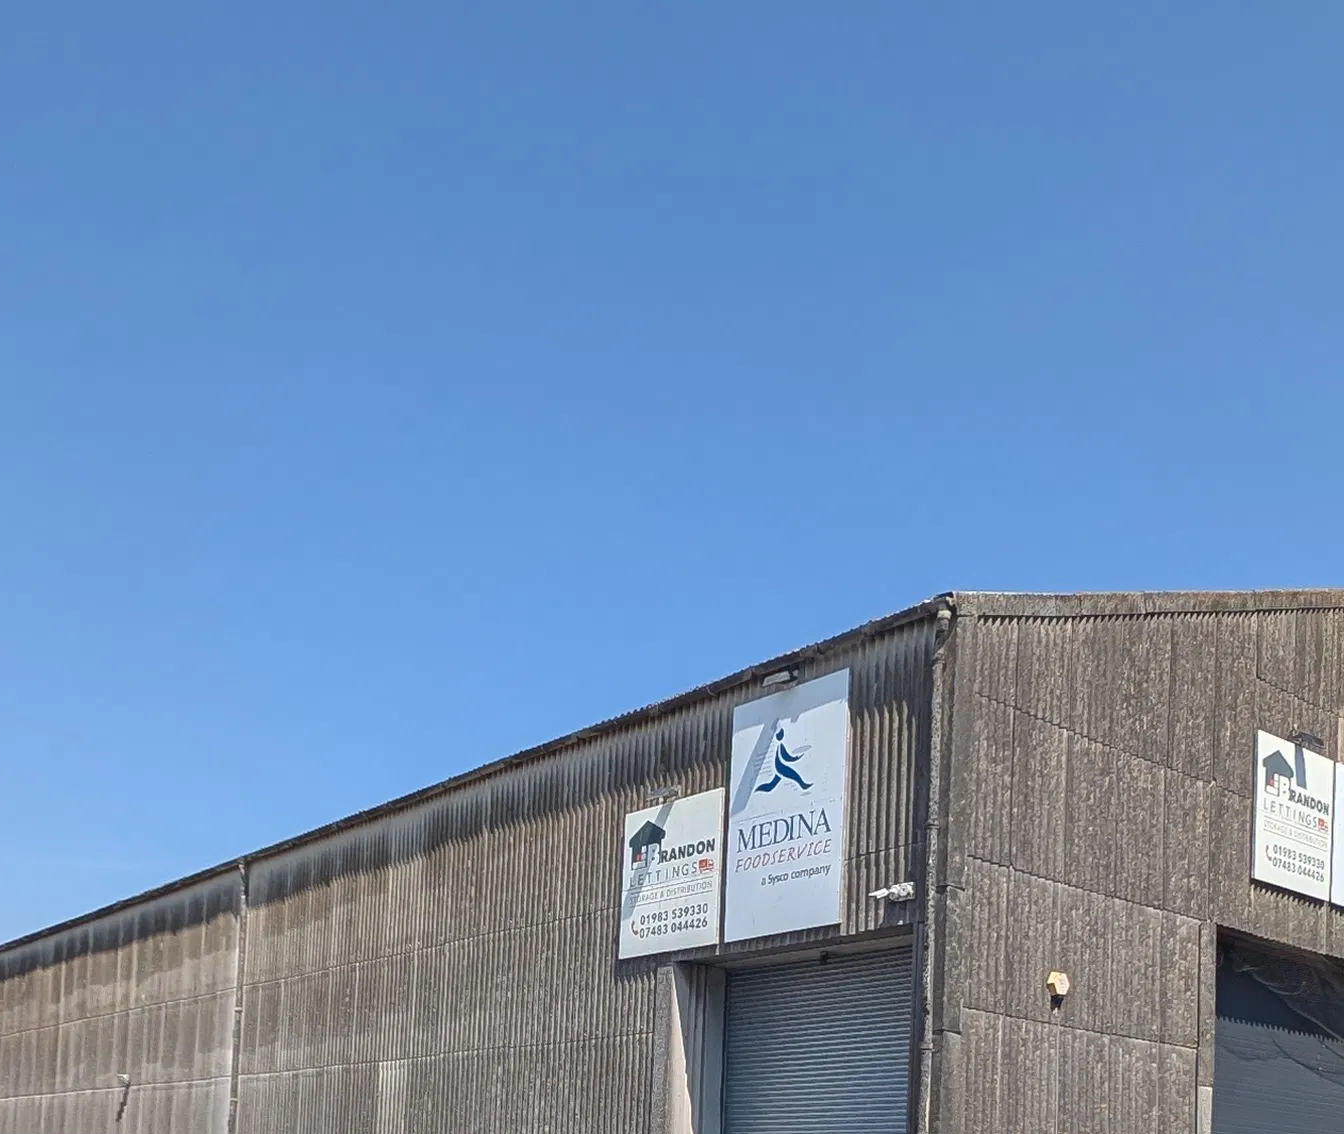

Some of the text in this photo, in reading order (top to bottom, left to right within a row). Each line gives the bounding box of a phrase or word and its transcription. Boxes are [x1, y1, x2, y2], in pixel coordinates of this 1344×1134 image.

[1263, 798, 1317, 828] LETTINGS
[737, 807, 832, 853] MEDINA
[735, 839, 832, 873] FOODSERVICE
[1272, 844, 1297, 861] 01983
[629, 861, 697, 888] LETTINGS
[761, 864, 831, 886] a Sysco company
[629, 881, 713, 905] STORAGE & DISTRIBUTION
[640, 903, 708, 925] 01983 539330
[639, 917, 708, 939] 07483 044426
